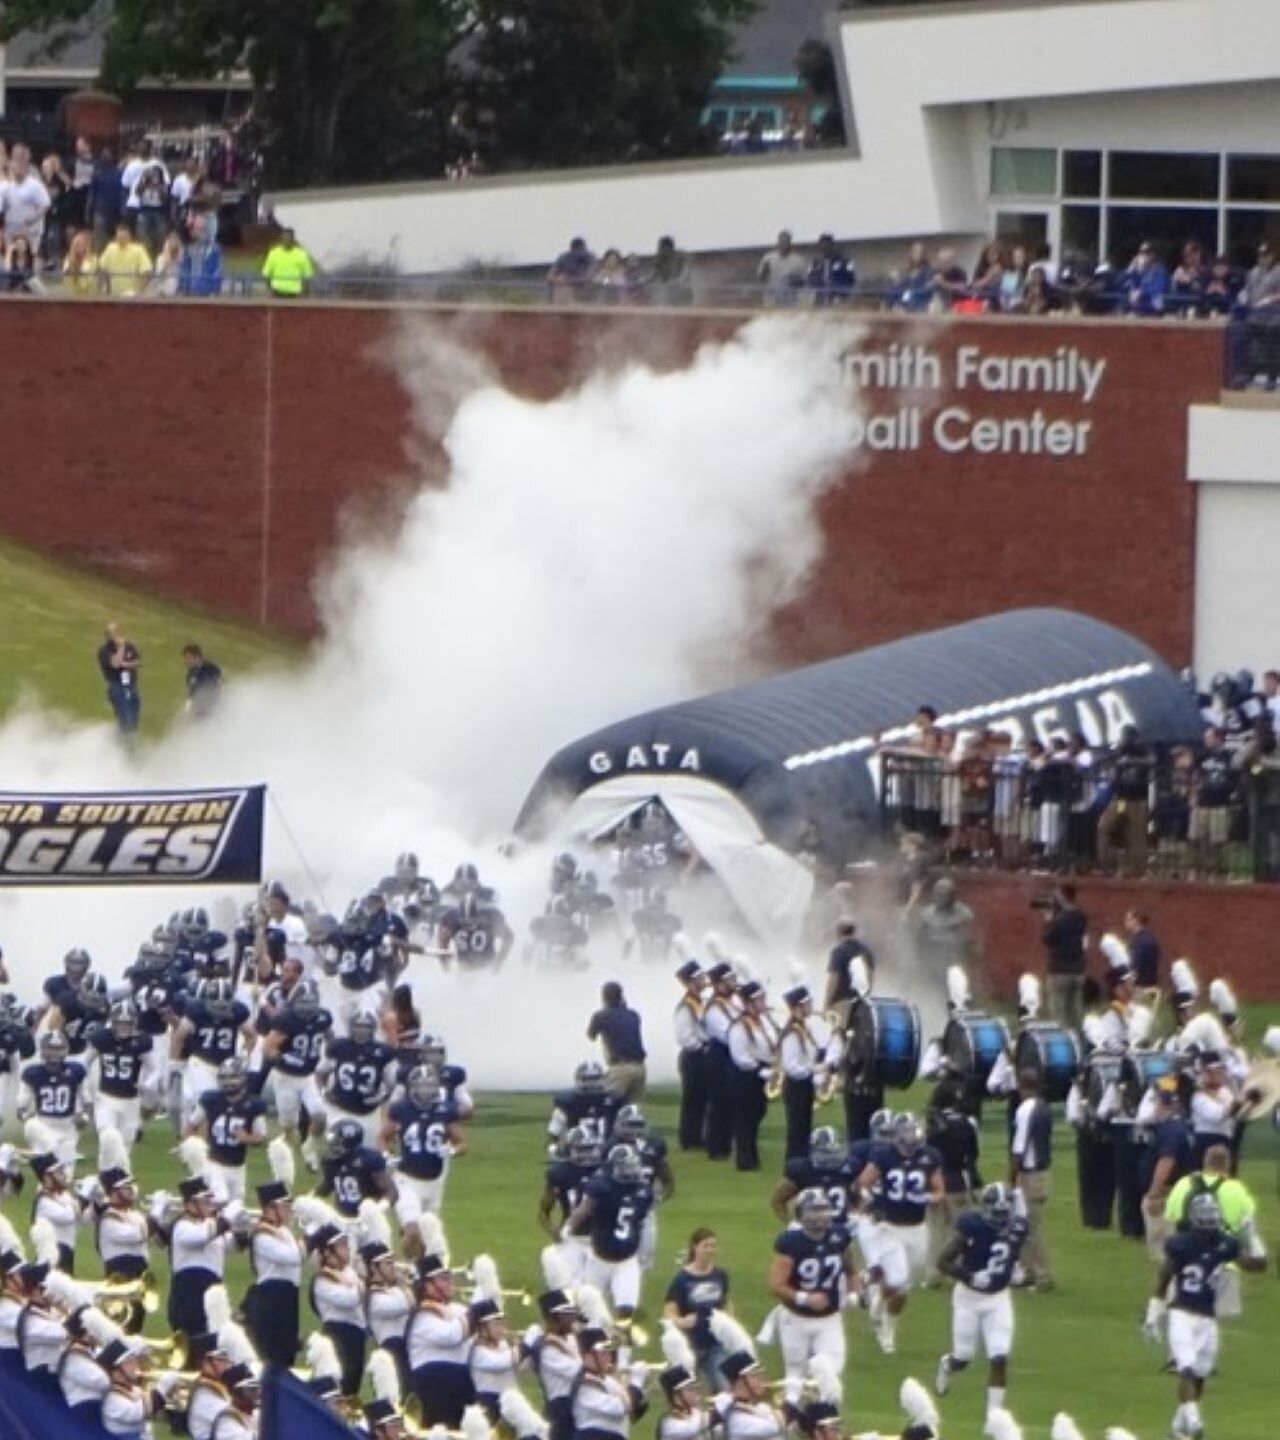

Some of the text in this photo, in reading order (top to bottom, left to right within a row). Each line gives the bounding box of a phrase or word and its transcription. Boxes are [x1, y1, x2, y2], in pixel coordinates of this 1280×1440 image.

[956, 347, 1106, 402] Family
[934, 408, 1091, 455] Center
[589, 743, 700, 773] GATA
[55, 799, 233, 824] SOUTHERN
[198, 1027, 234, 1050] 72
[103, 1053, 134, 1080] 55
[338, 1063, 377, 1093] 63
[39, 1085, 71, 1112] 20
[402, 1122, 446, 1153] 46
[614, 1206, 636, 1240] 5
[798, 1252, 843, 1289] 97
